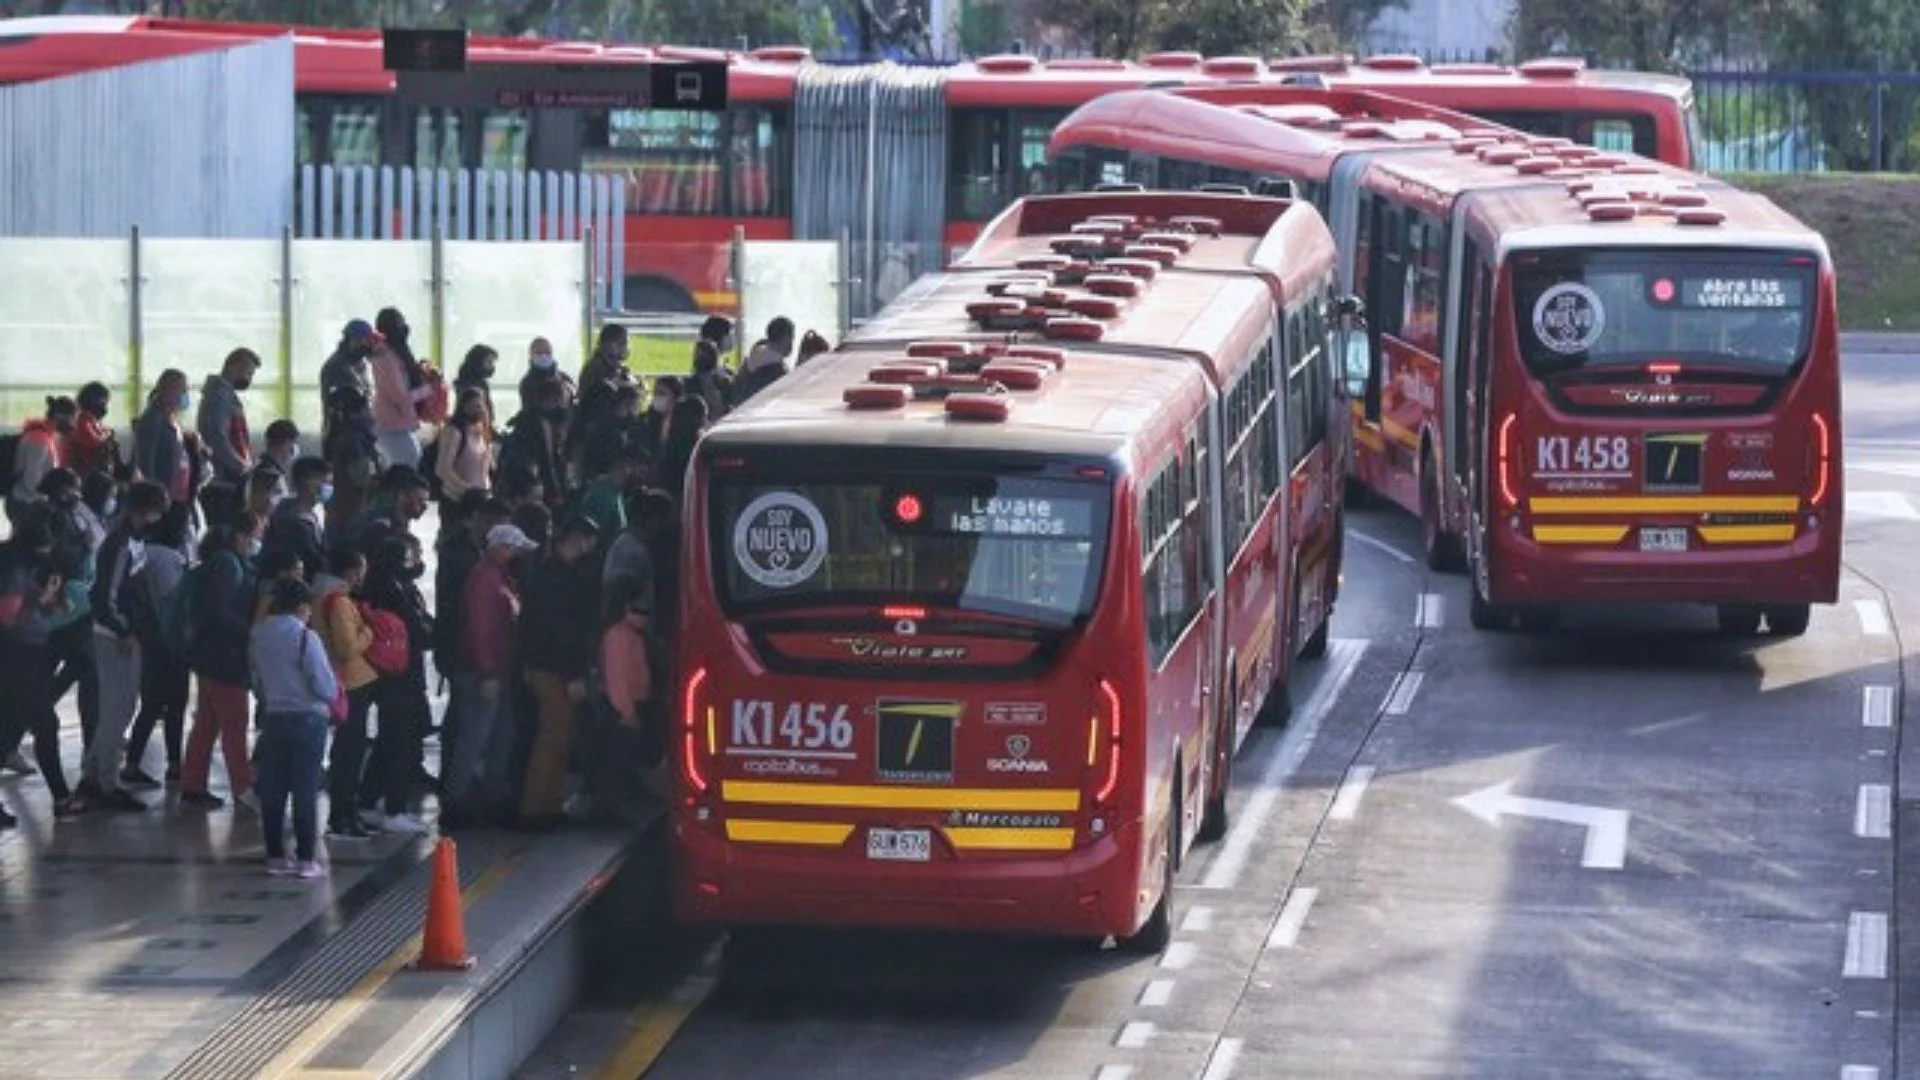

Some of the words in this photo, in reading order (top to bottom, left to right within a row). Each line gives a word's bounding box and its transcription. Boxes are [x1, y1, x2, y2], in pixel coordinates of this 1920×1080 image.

[1537, 436, 1630, 471] K1458
[767, 508, 794, 527] SOY
[951, 512, 986, 533] las
[991, 516, 1064, 535] manos
[748, 527, 812, 553] NUEVO
[732, 700, 854, 749] K1456
